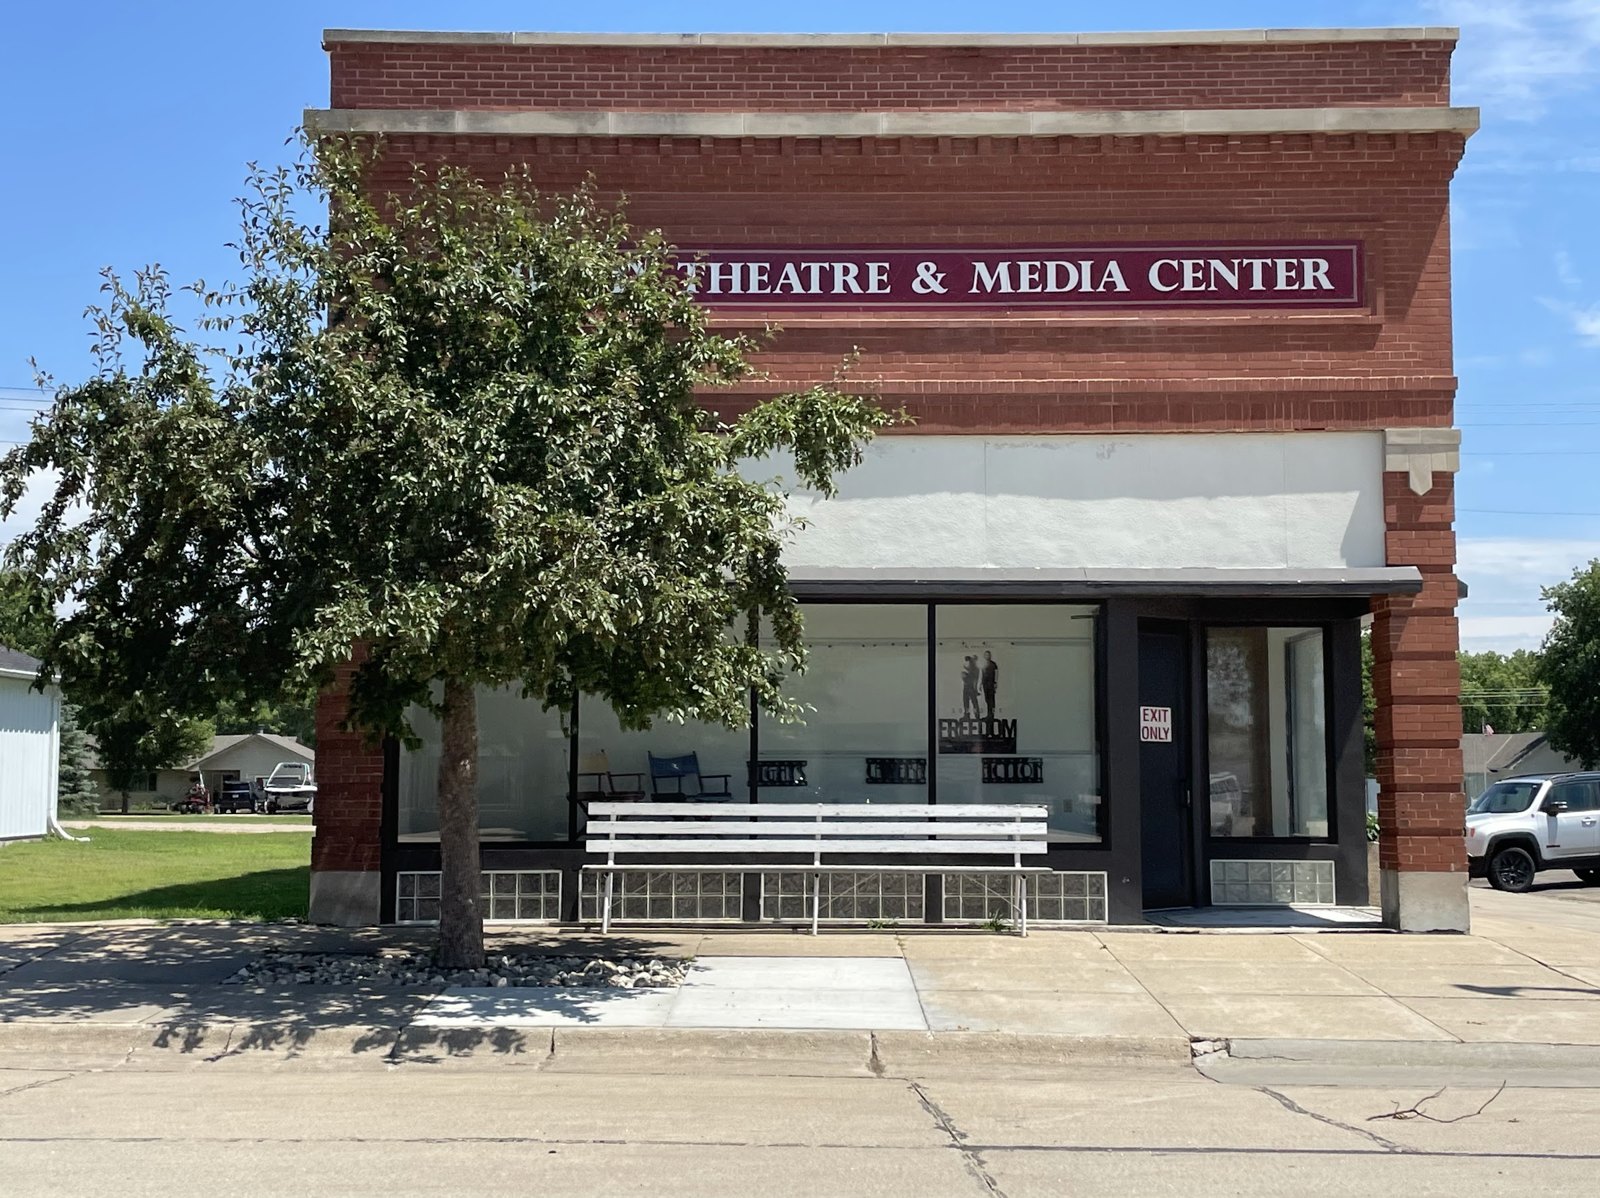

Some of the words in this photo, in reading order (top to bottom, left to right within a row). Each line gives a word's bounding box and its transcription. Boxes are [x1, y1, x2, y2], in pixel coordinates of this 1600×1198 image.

[677, 261, 891, 295] THEATRE
[911, 261, 949, 295] &
[967, 259, 1131, 294] MEDIA
[1147, 257, 1335, 293] CENTER
[1142, 708, 1169, 723] EXIT
[938, 718, 1017, 739] FREEDOM
[1141, 726, 1170, 741] ONLY
